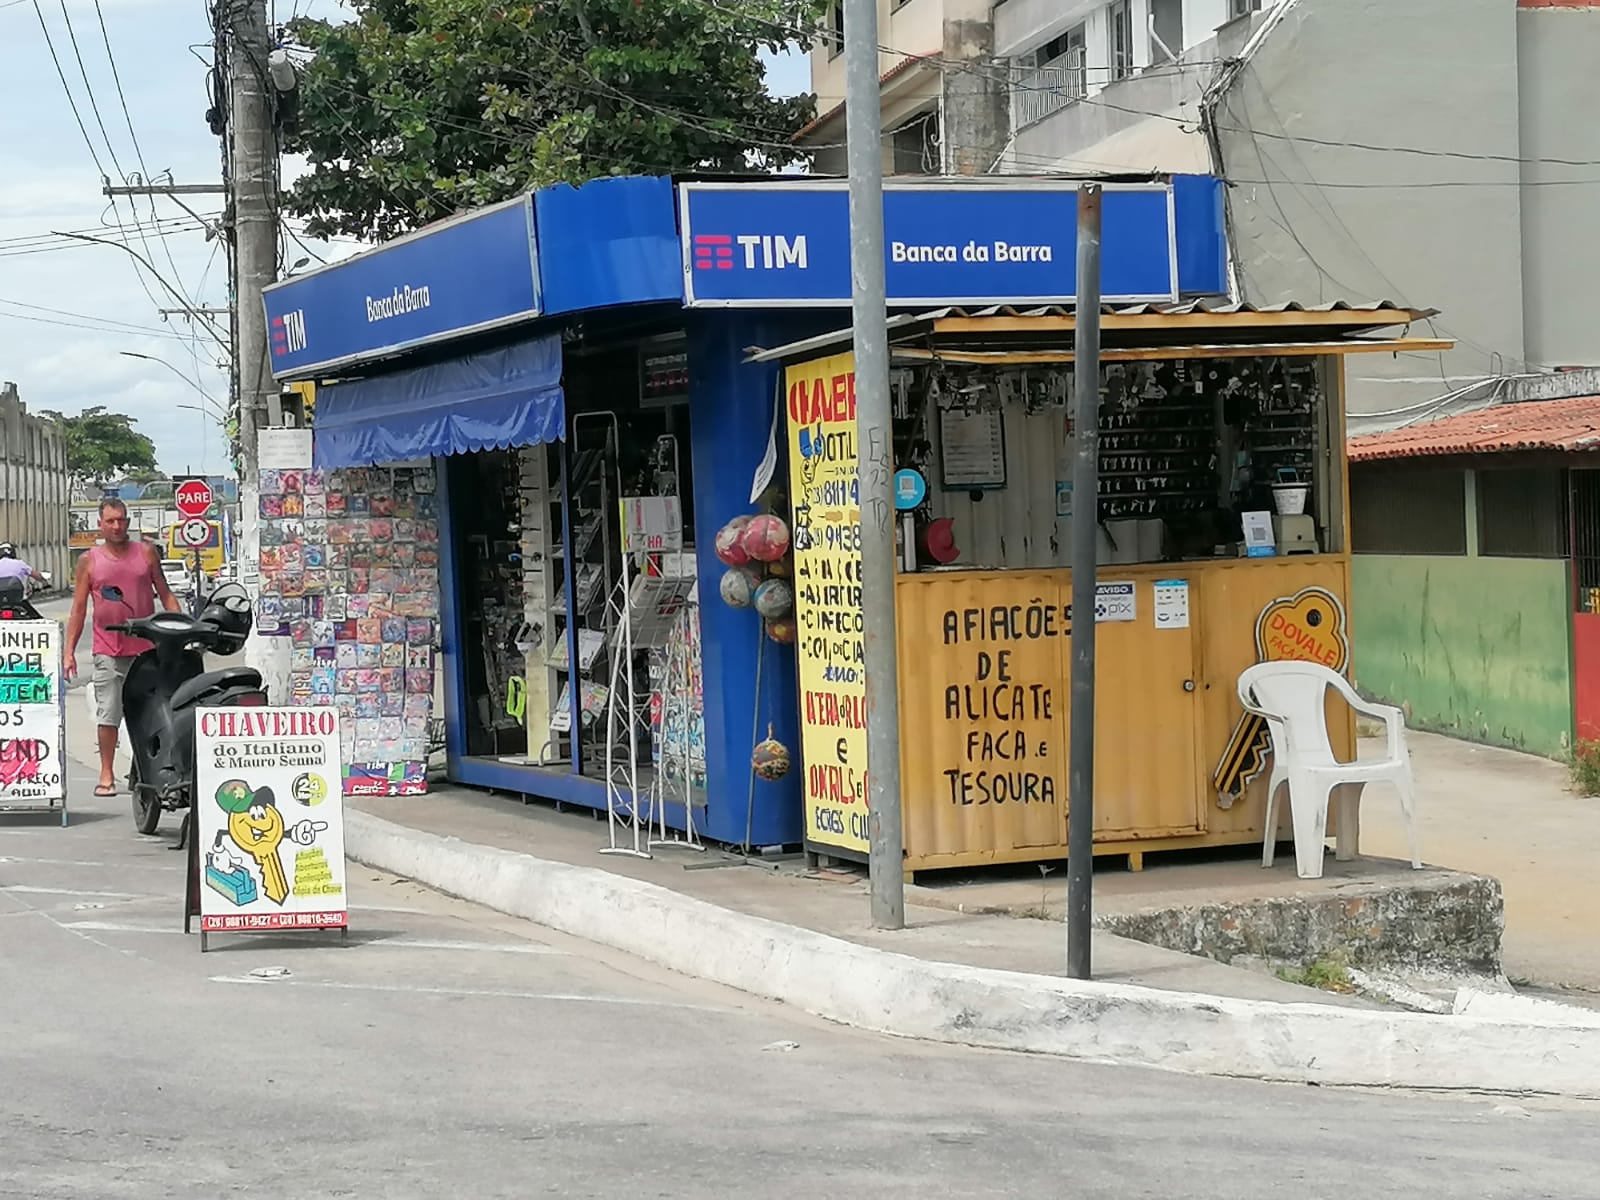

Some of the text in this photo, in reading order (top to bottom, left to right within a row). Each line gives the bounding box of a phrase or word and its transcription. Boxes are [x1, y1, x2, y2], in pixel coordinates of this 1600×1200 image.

[737, 234, 808, 270] TIM
[891, 240, 1052, 263] Banca da Barra
[365, 284, 431, 323] Banca da Barra
[283, 308, 307, 353] TIM
[178, 491, 210, 505] PARE
[1270, 613, 1337, 666] DOVALE
[977, 650, 1011, 682] DE
[945, 683, 1052, 721] ALICATE
[201, 711, 335, 737] CHAVEIRO
[214, 742, 322, 756] do Italiano
[214, 755, 323, 768] & Mauro Senna
[943, 768, 1055, 806] TESOURA
